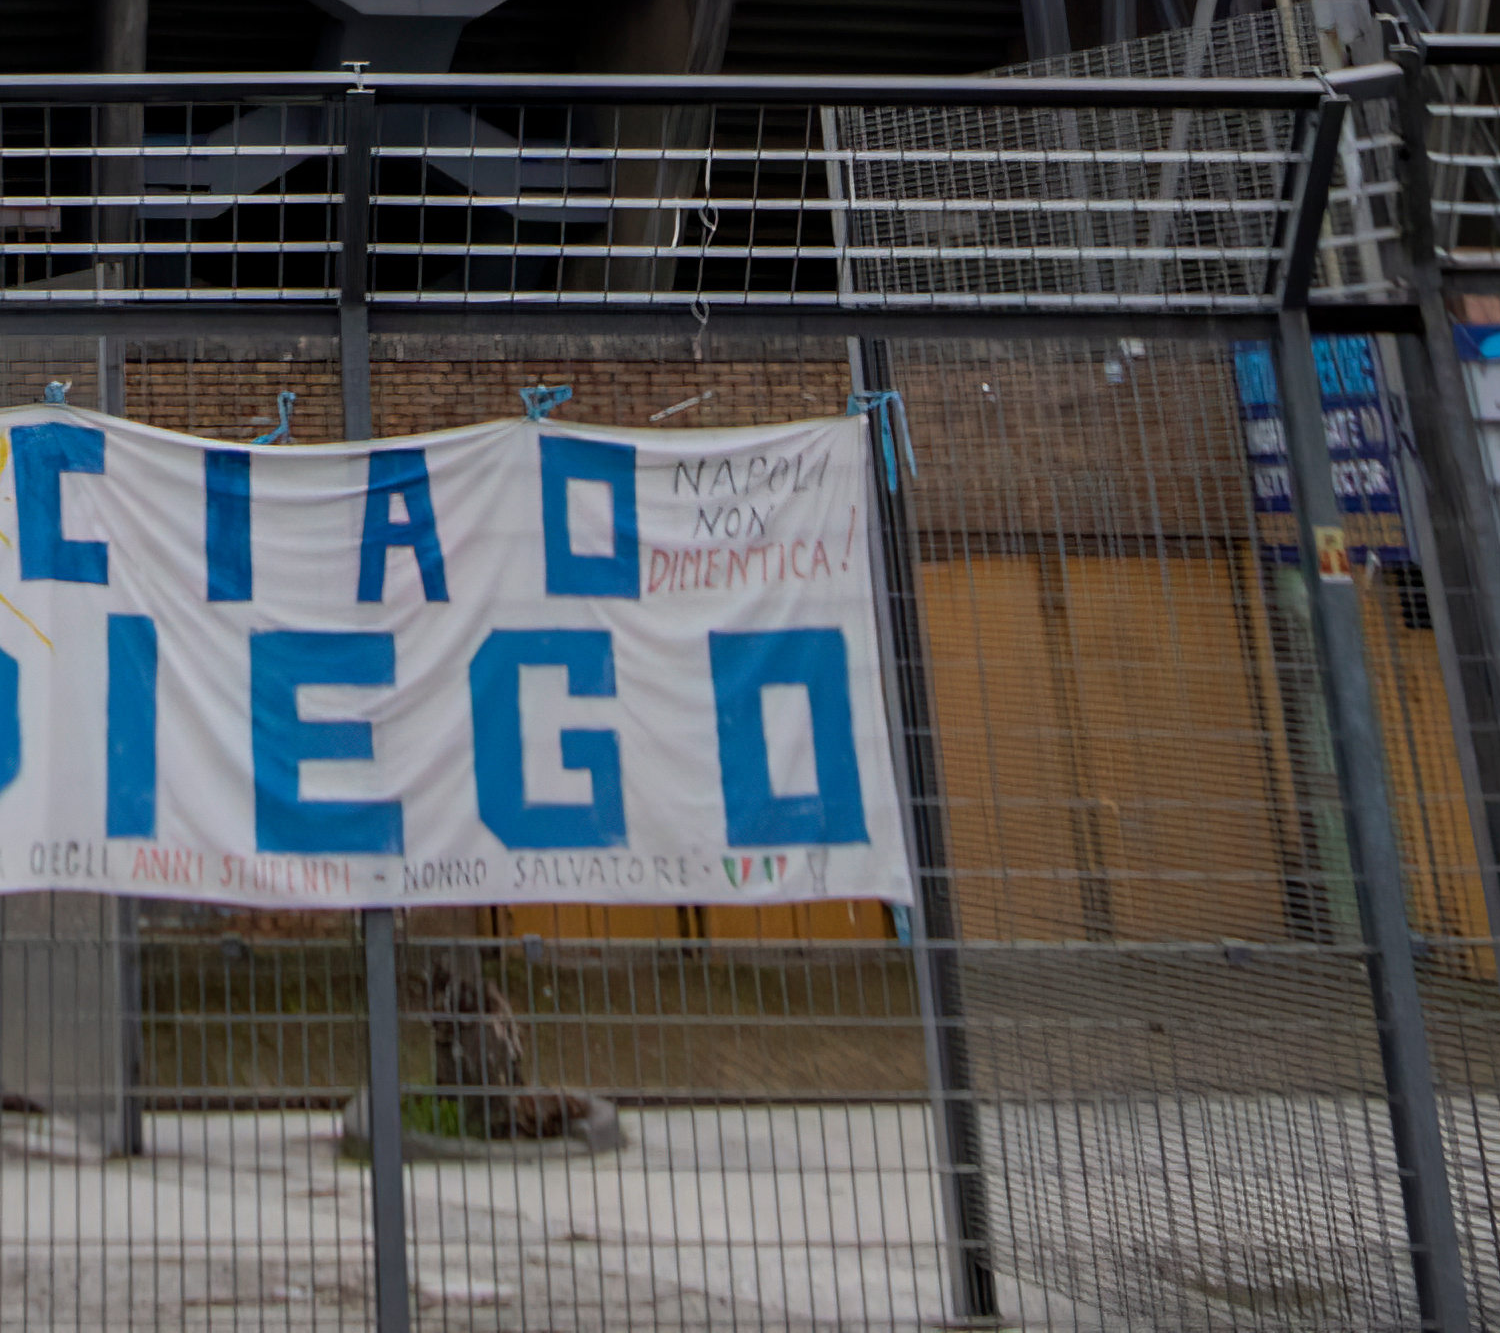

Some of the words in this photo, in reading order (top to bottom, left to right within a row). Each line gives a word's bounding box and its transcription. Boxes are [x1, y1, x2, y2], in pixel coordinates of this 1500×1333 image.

[673, 448, 833, 497] NAPOLI
[9, 421, 640, 604] CIAO
[693, 504, 776, 539] NON
[131, 847, 205, 884] ANNI
[218, 853, 351, 895] STUPENDI
[402, 857, 488, 894] NONNO
